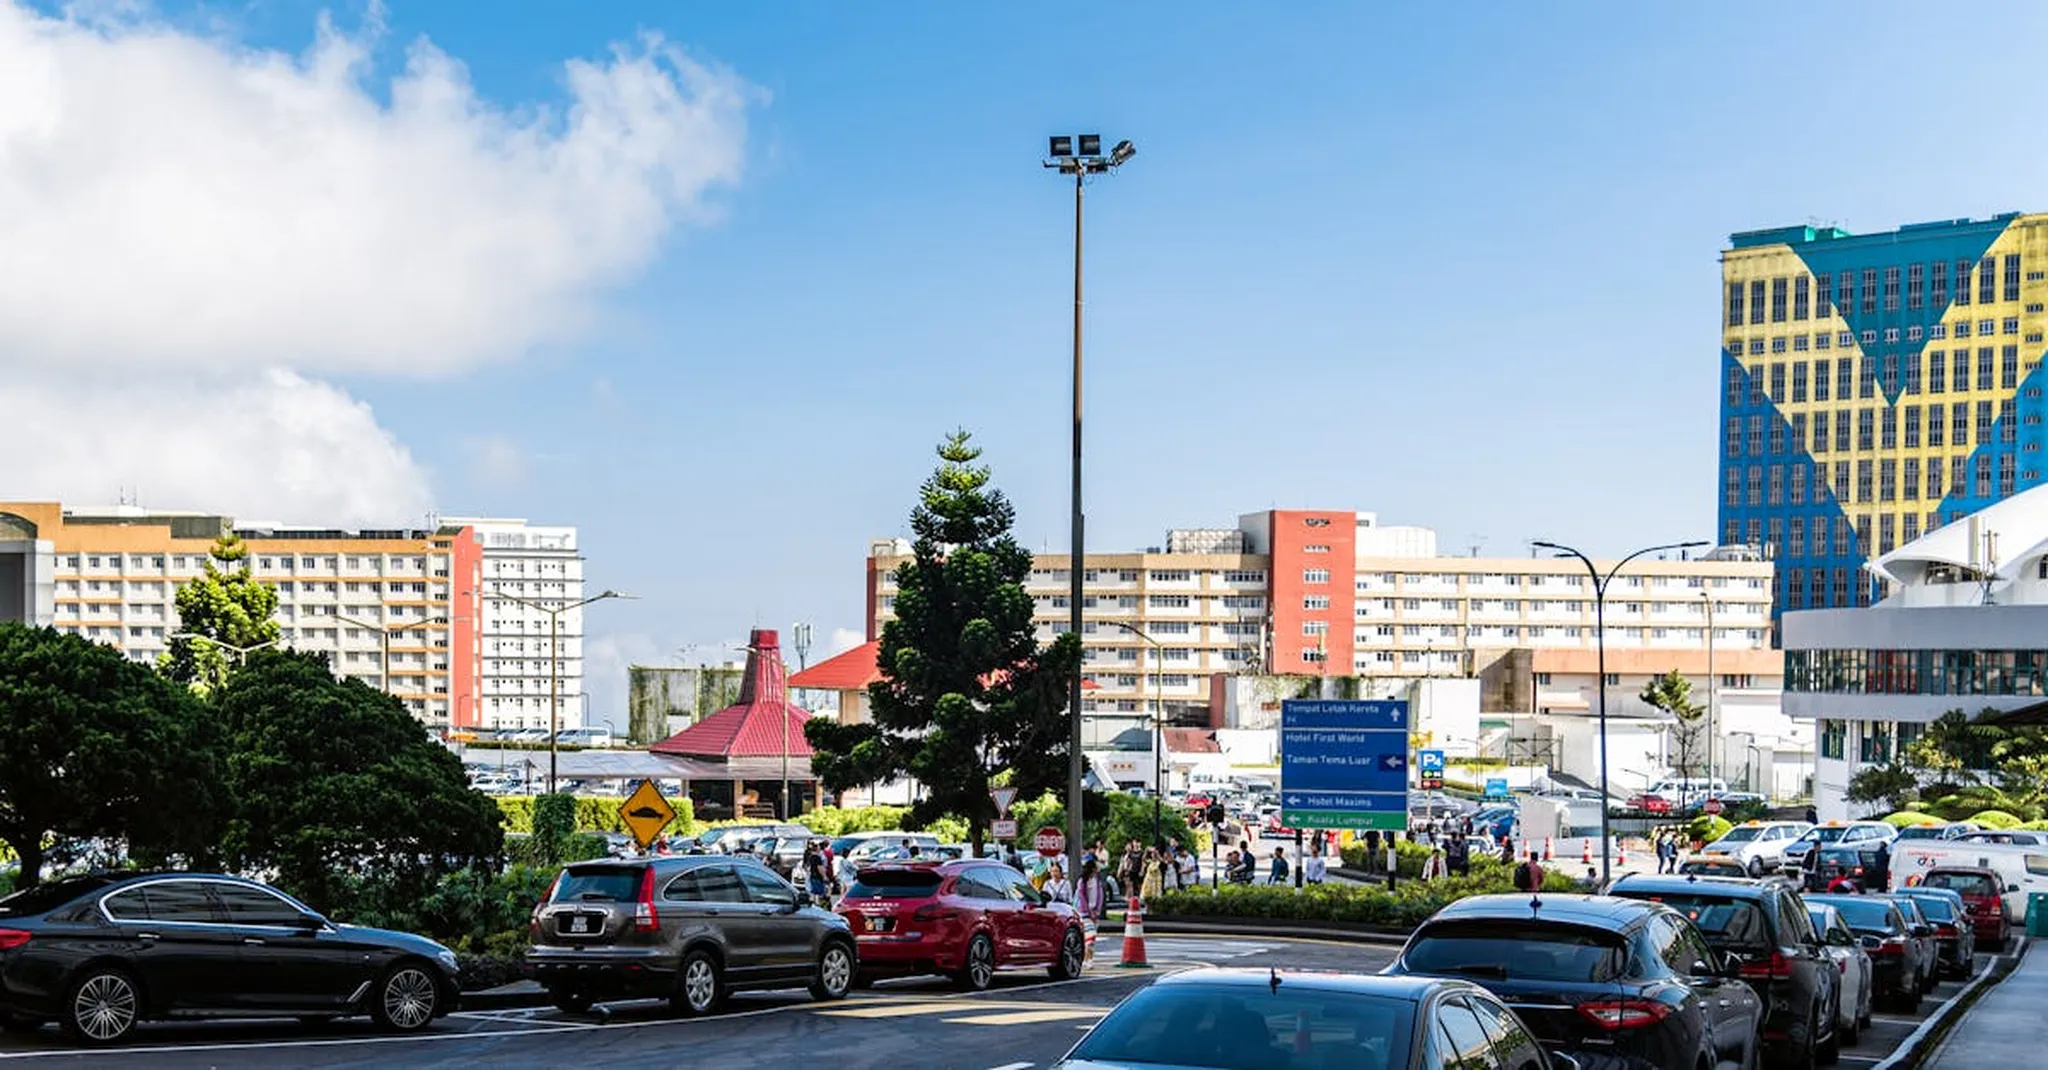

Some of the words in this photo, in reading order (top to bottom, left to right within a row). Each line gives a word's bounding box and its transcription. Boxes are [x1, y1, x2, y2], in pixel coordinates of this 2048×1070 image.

[1287, 703, 1320, 714] Tempat
[1322, 704, 1346, 713] Letak
[1349, 704, 1379, 713] Kereta
[1286, 733, 1311, 743] Hotel
[1313, 733, 1335, 742] First
[1338, 733, 1365, 743] World
[1287, 754, 1318, 764] Taman
[1320, 755, 1346, 764] Tema
[1348, 756, 1371, 765] Luar
[1423, 754, 1441, 767] P4
[1307, 796, 1333, 806] Hotel
[1335, 797, 1372, 807] Maxims
[1307, 815, 1334, 824] Kuala
[1336, 816, 1373, 826] Lumpur
